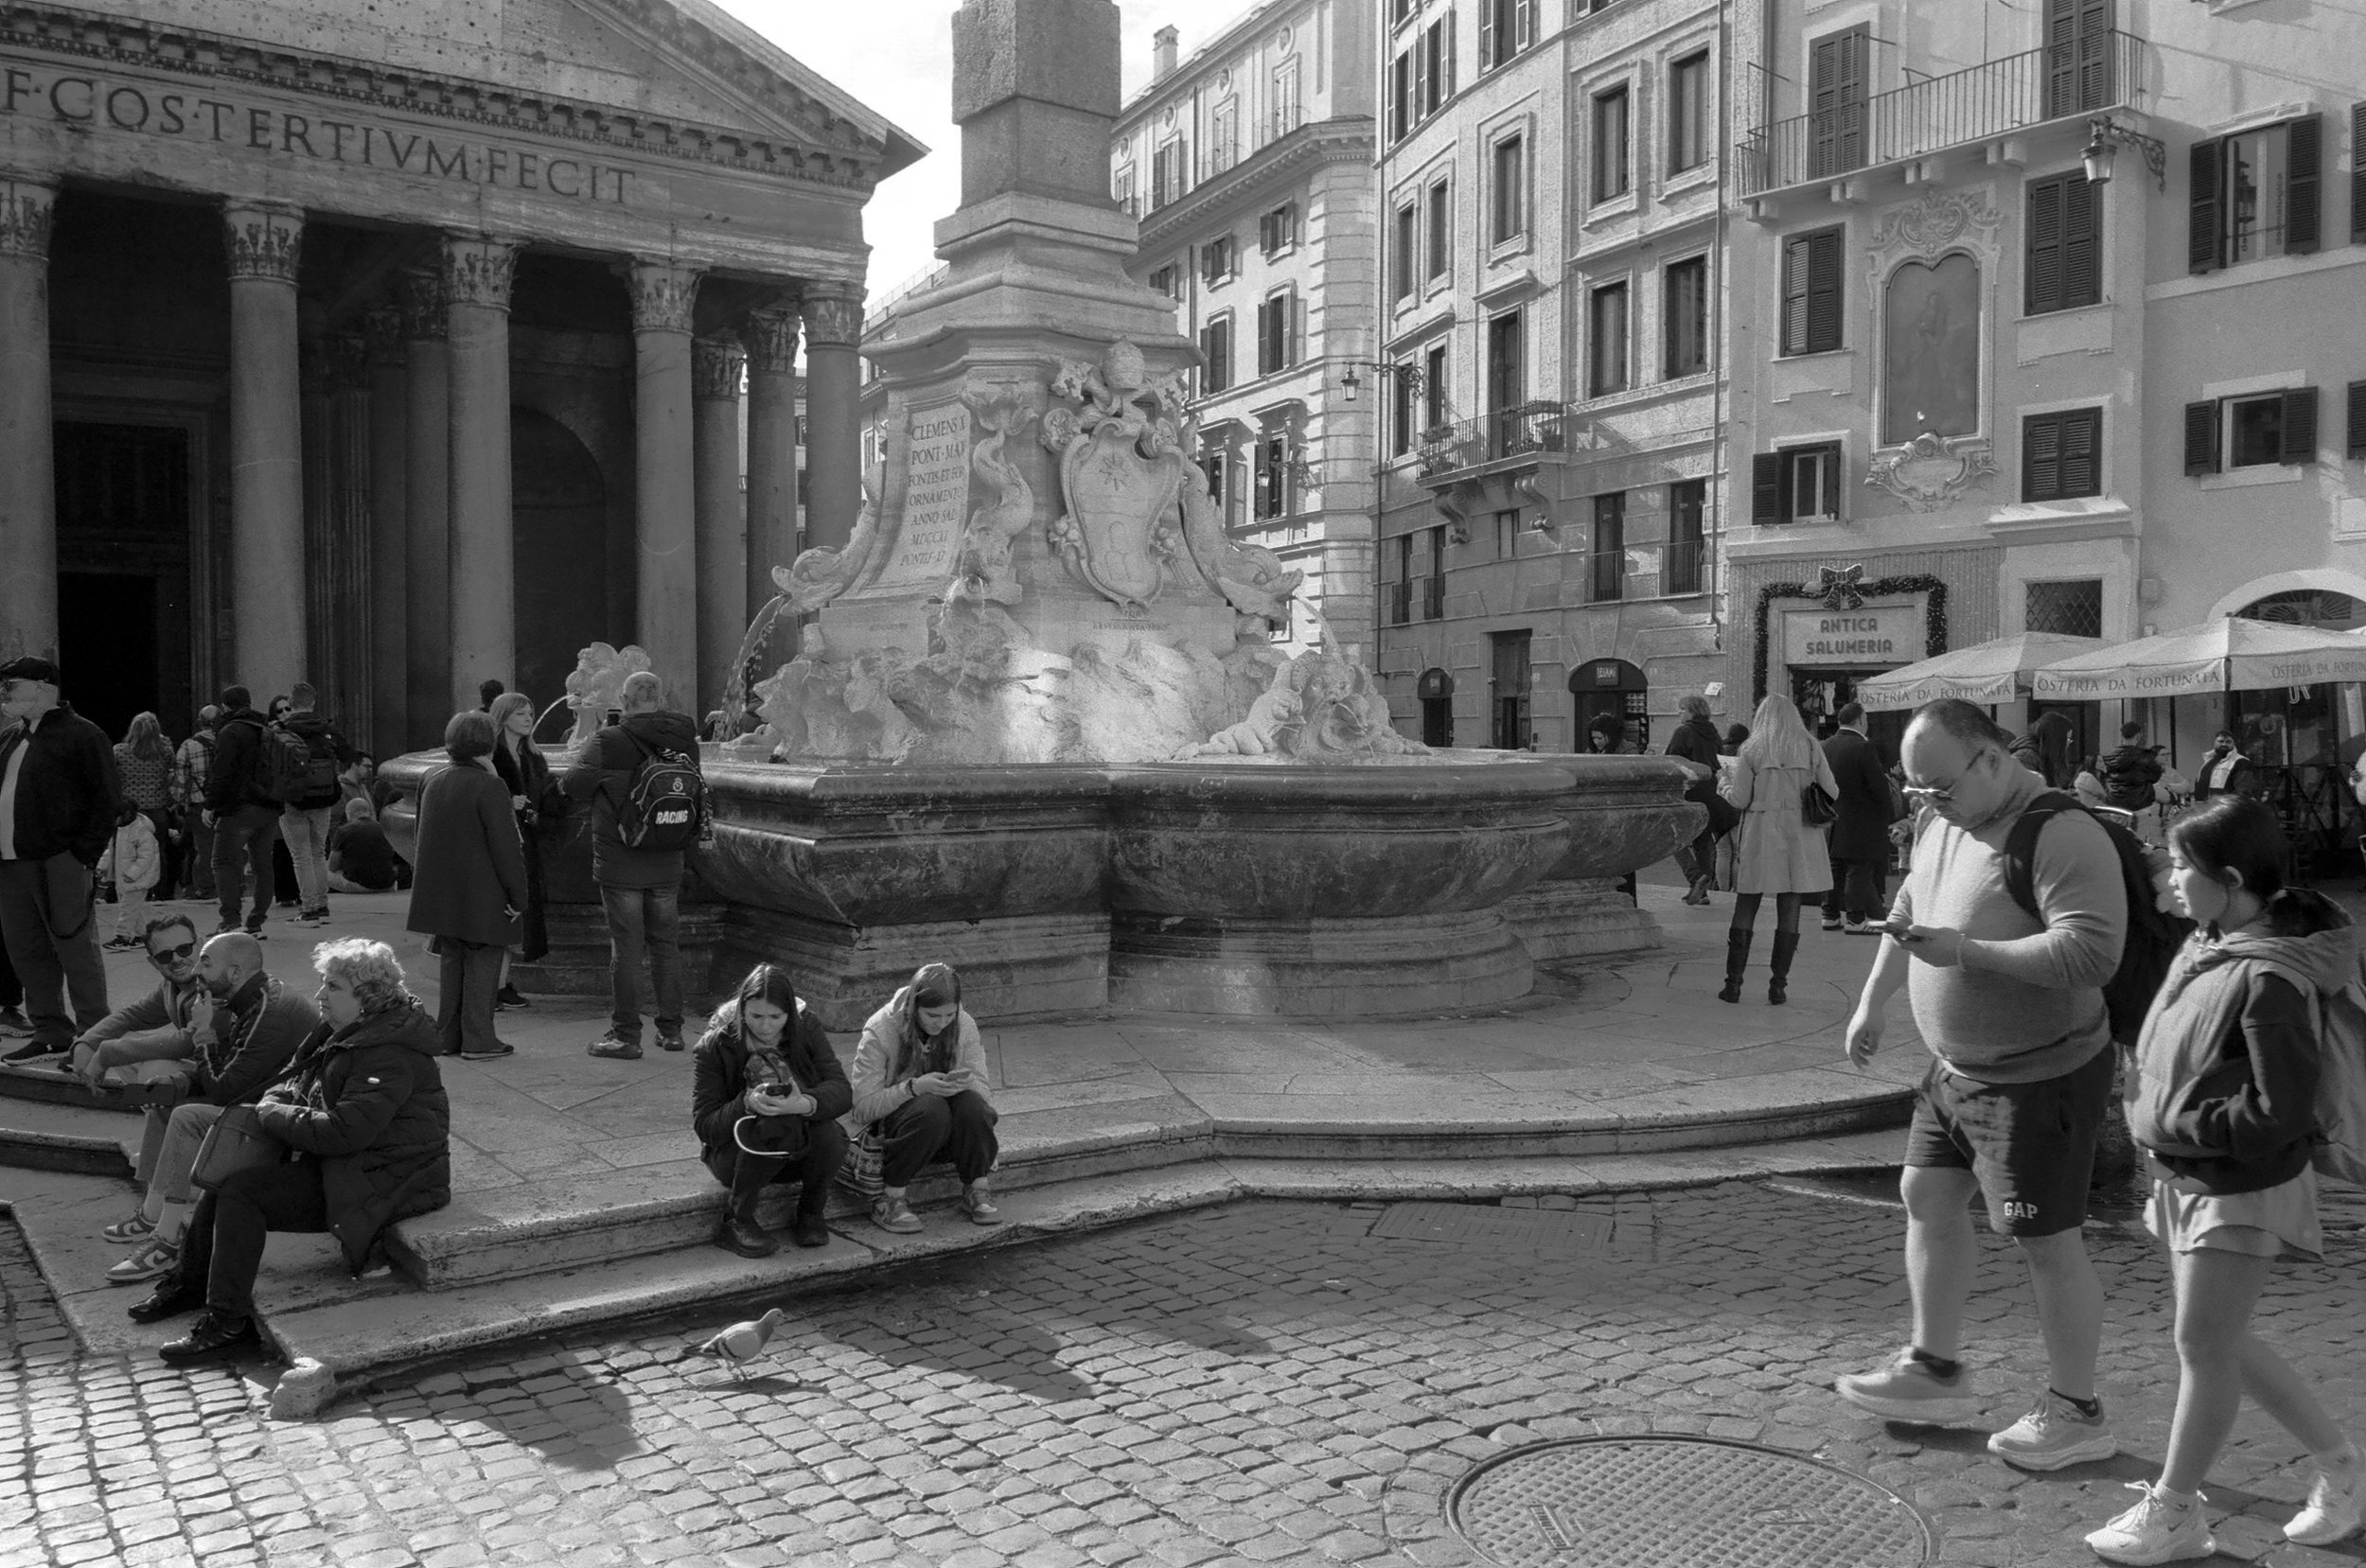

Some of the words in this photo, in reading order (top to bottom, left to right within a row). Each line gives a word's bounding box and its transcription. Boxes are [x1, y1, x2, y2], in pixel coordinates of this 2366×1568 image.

[49, 77, 185, 135] COS
[198, 99, 471, 183] TERTIVM
[486, 149, 637, 204] FECIT
[1820, 618, 1879, 633] ANTICA
[1806, 639, 1893, 655] SALUMERIA
[2271, 663, 2312, 679] OSTERIA
[2037, 678, 2099, 692] OSTERIA
[2109, 678, 2128, 691] DA
[2135, 671, 2220, 689] FORTUNATA
[1860, 691, 1910, 705] OSTERIA
[1917, 689, 1932, 700] DA
[1940, 685, 2011, 699] FORTUNATA
[655, 809, 689, 825] RACING
[2004, 1202, 2039, 1219] GAP
